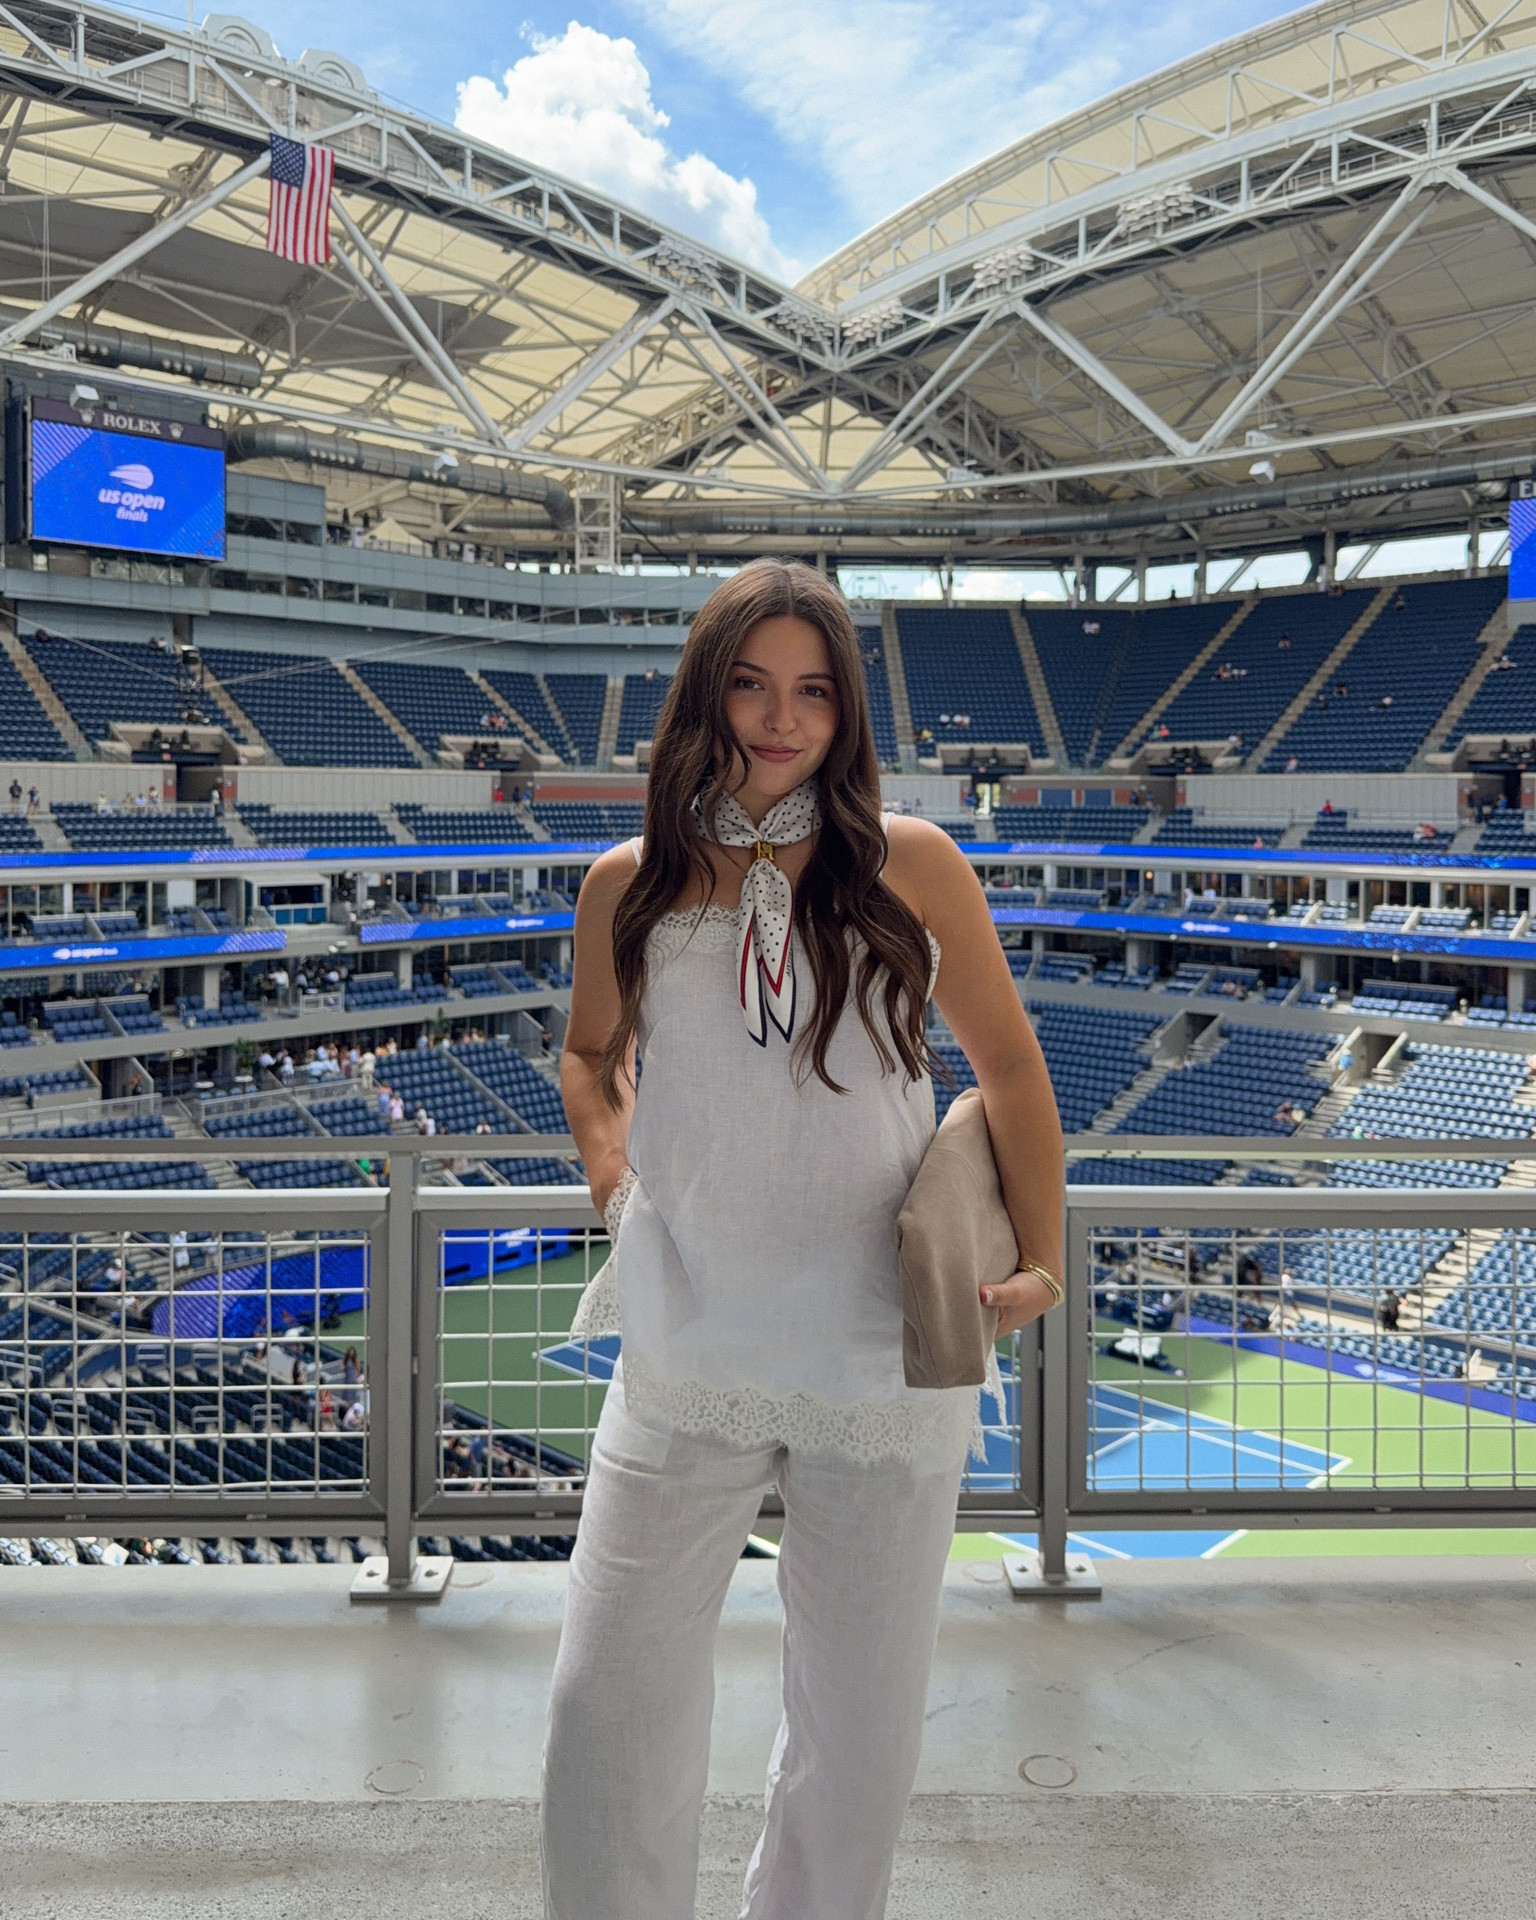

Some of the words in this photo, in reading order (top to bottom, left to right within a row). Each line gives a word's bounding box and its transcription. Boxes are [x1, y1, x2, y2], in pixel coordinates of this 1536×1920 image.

[103, 412, 161, 435] ROLEX
[98, 488, 120, 504] us
[121, 491, 166, 511] open
[116, 506, 148, 523] finals
